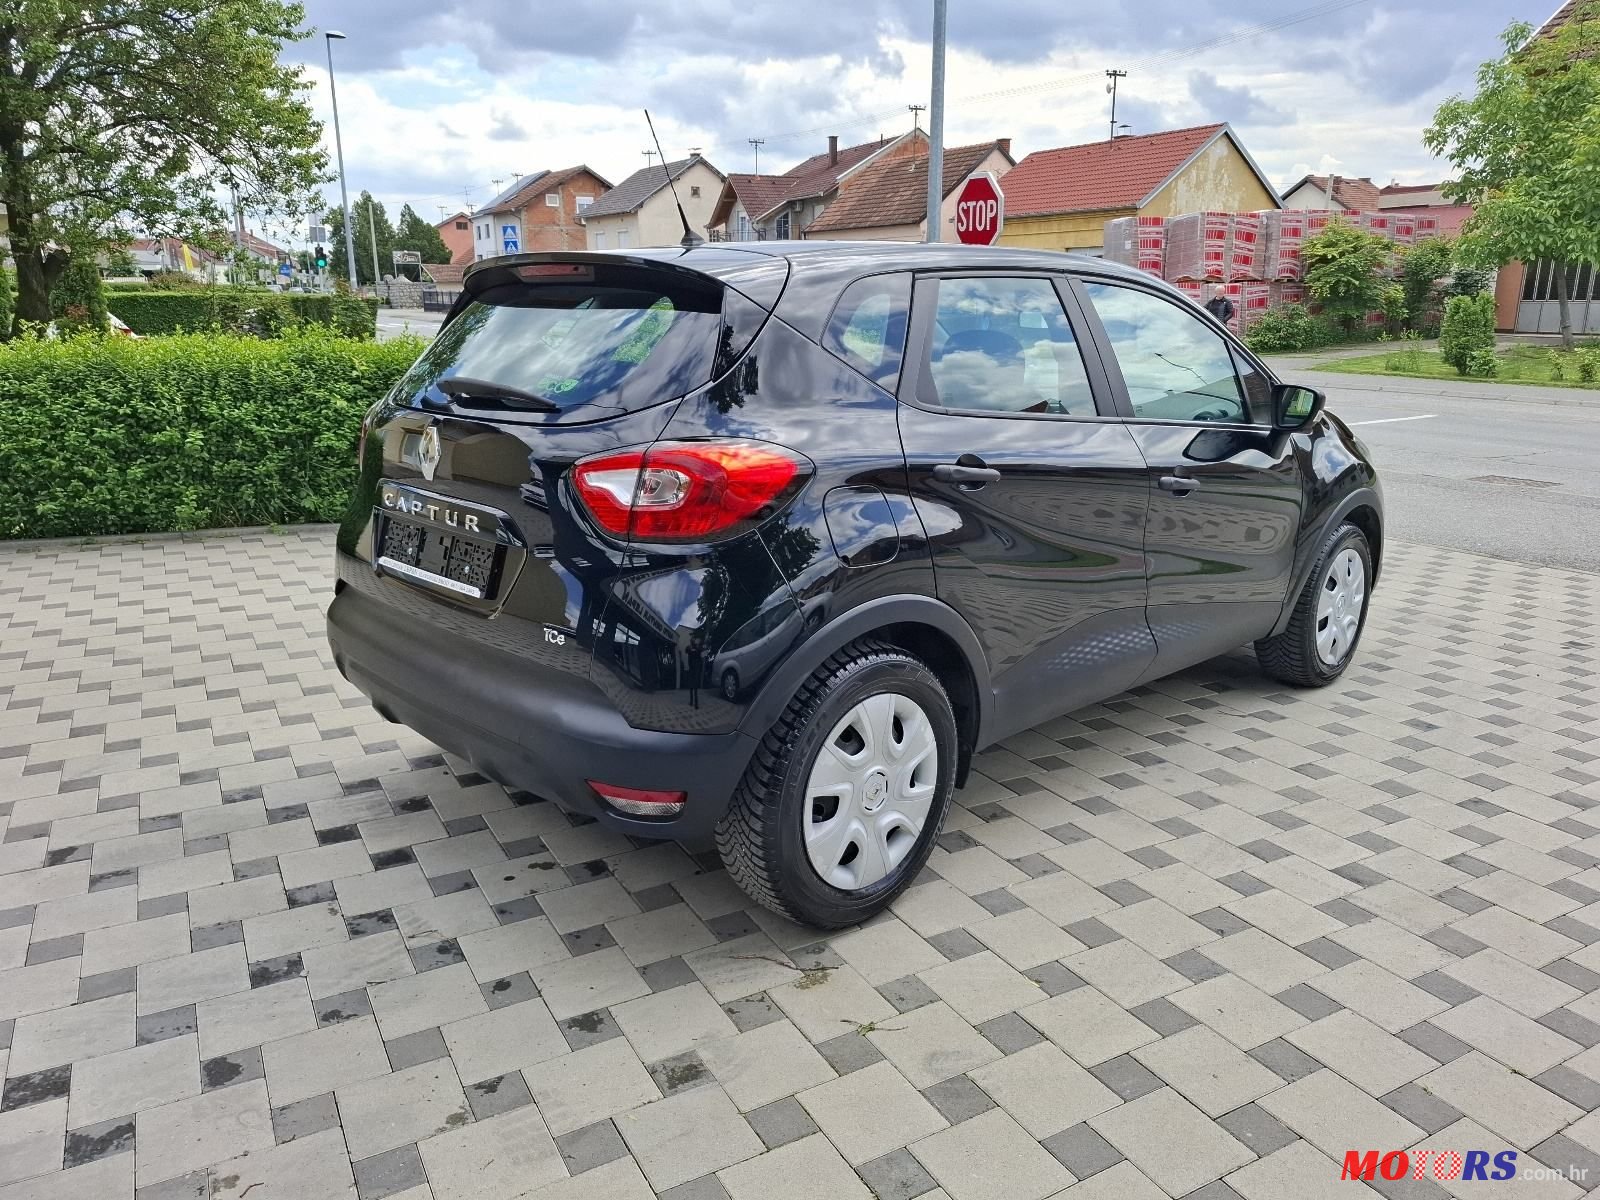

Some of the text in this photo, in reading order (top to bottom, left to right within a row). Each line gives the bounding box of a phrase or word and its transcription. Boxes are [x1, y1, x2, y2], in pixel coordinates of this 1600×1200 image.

[958, 200, 997, 231] STOP
[384, 493, 480, 532] CAPTUR
[543, 627, 566, 646] TCe
